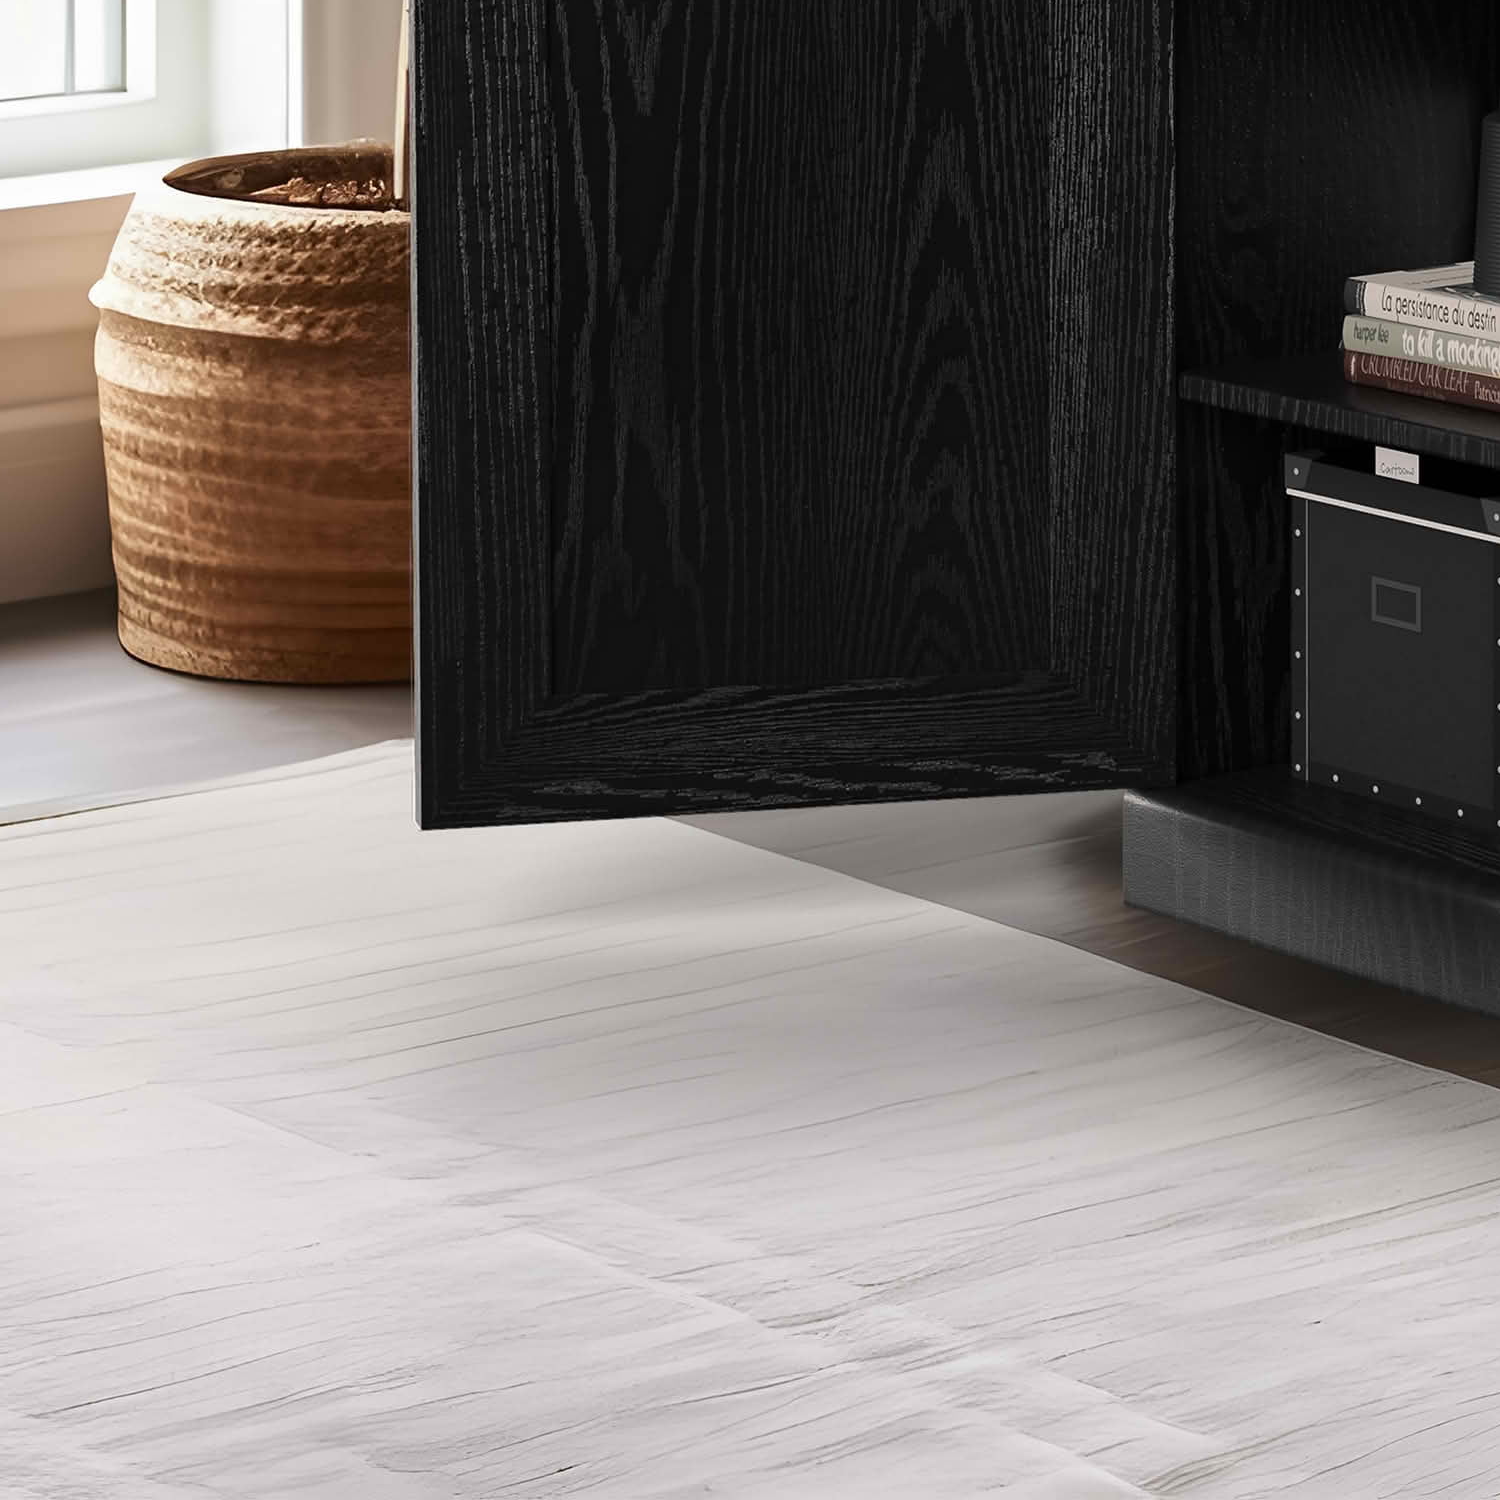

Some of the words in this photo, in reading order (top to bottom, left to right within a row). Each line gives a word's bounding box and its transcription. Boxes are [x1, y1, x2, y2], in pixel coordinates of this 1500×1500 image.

[1381, 285, 1392, 312] La
[1395, 293, 1450, 324] persistance
[1452, 299, 1465, 327] du
[1468, 303, 1497, 333] destin
[1353, 323, 1377, 345] harper
[1402, 329, 1415, 356] to
[1417, 330, 1435, 360] kill
[1436, 337, 1445, 363] a
[1360, 355, 1418, 382] CRUMBLED
[1418, 362, 1442, 389] OAK
[1444, 367, 1470, 394] LEAF
